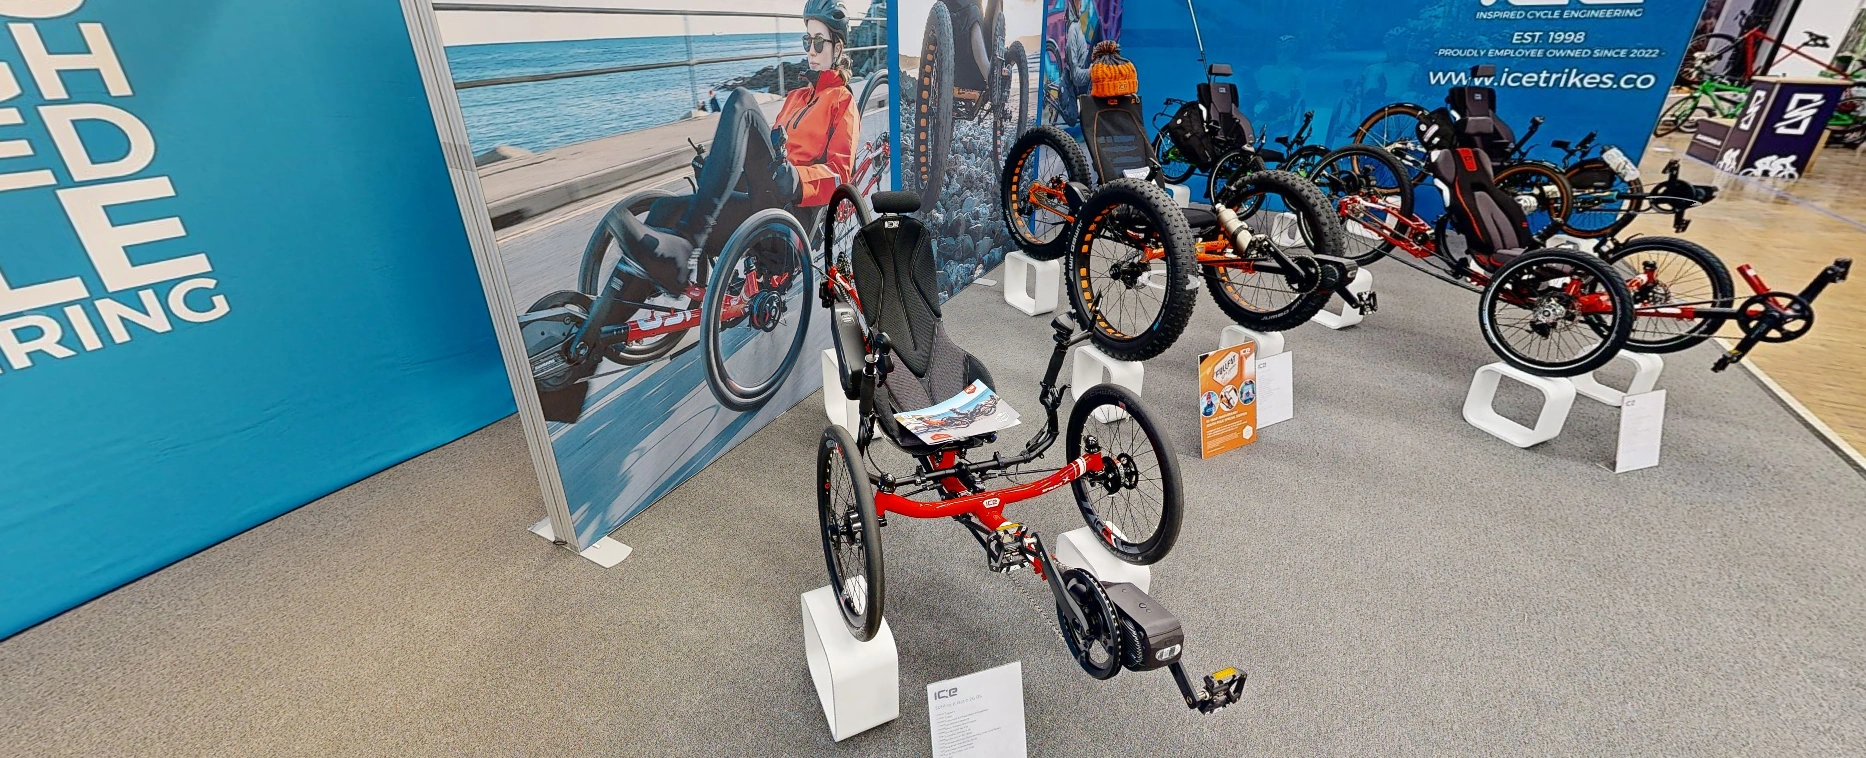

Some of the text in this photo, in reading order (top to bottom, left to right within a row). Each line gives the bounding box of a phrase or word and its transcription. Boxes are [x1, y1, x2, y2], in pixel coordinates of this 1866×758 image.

[1475, 8, 1644, 20] INSPIRED CYCLE ENGINEERING
[1512, 31, 1586, 44] EST. 1998
[1487, 49, 1544, 58] EMPLOYEE
[1546, 49, 1591, 58] OWNED
[1592, 49, 1627, 58] SINCE
[1629, 49, 1659, 58] 2022
[1428, 68, 1657, 90] www.icetrikes.co
[0, 278, 232, 373] RING
